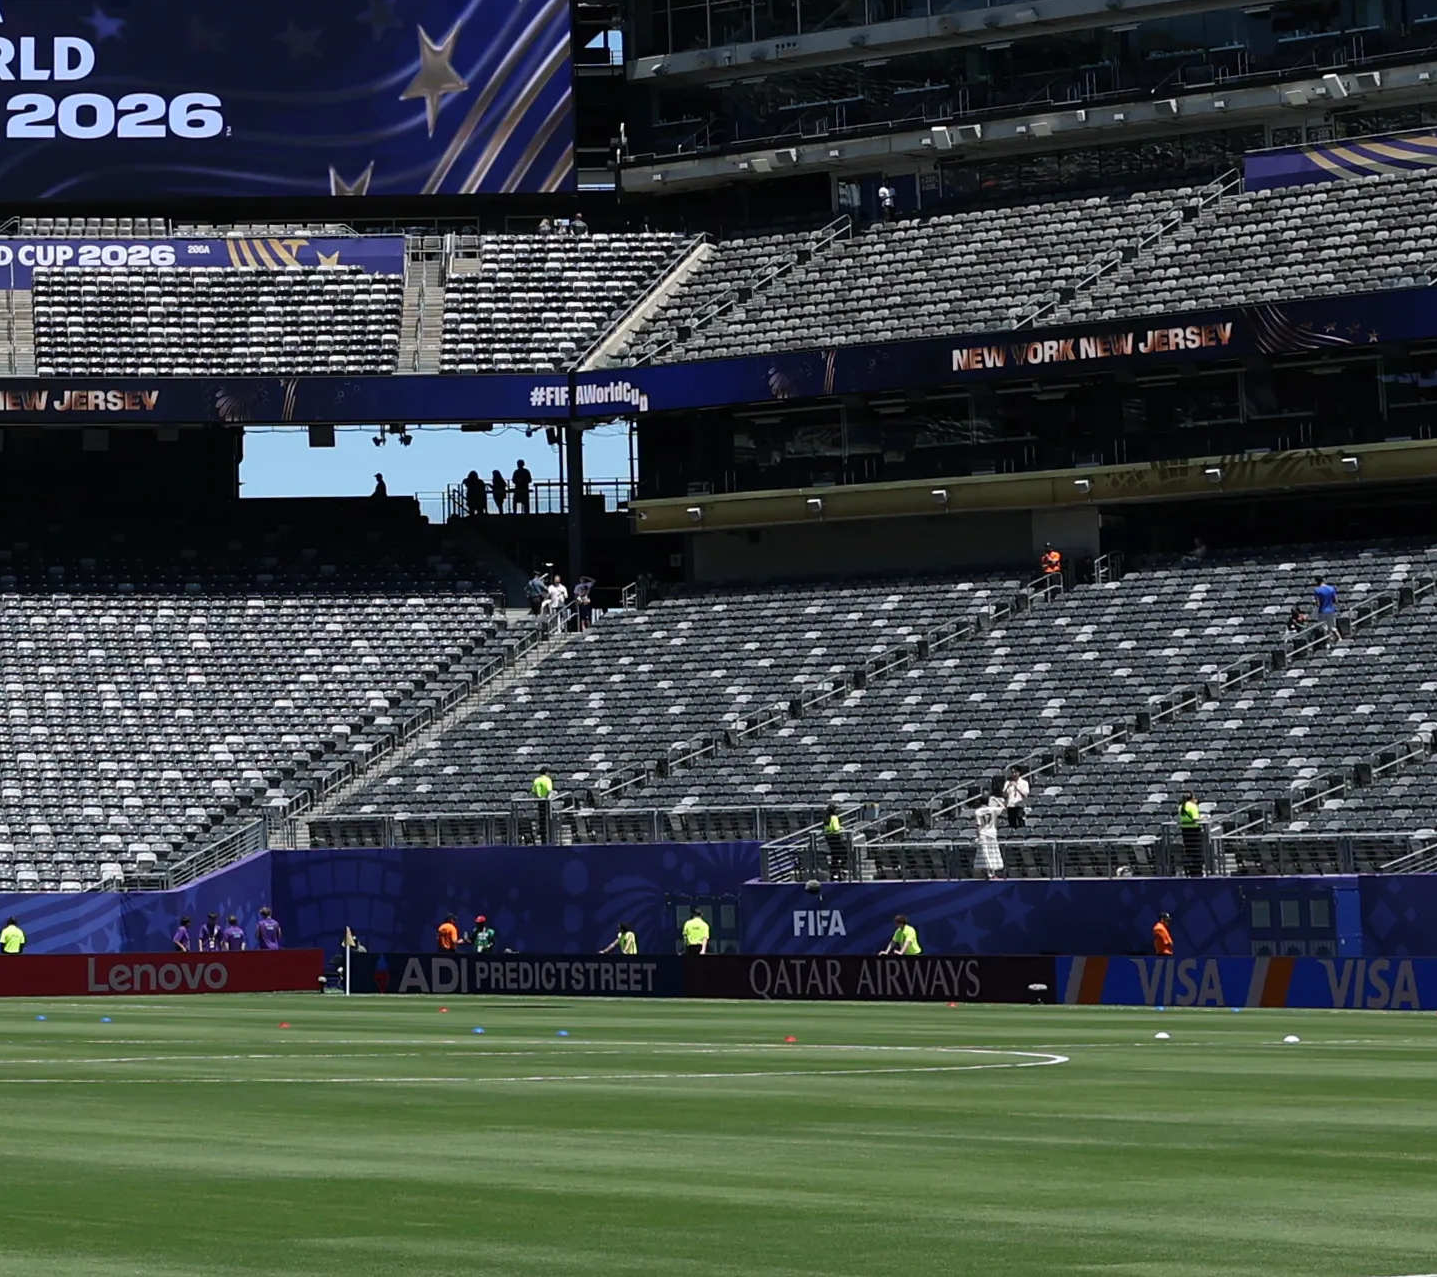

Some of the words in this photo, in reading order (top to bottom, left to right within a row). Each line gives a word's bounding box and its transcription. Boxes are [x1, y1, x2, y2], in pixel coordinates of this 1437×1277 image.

[6, 92, 224, 140] 2026
[18, 243, 74, 268] CUP
[78, 244, 176, 268] 2026
[952, 346, 1007, 372] NEW
[1011, 339, 1076, 367] YORK
[1078, 332, 1133, 360] NEW
[1137, 320, 1234, 354] JERSEY
[54, 389, 159, 413] JERSEY
[792, 909, 847, 938] FIFA
[87, 957, 228, 992] Lenovo
[398, 960, 469, 995] ADI
[475, 961, 657, 993] PREDICTSTREET
[749, 958, 844, 1001] QATAR
[857, 959, 981, 998] AIRWAYS
[1128, 958, 1225, 1008] VISA
[1325, 958, 1420, 1010] VISA
